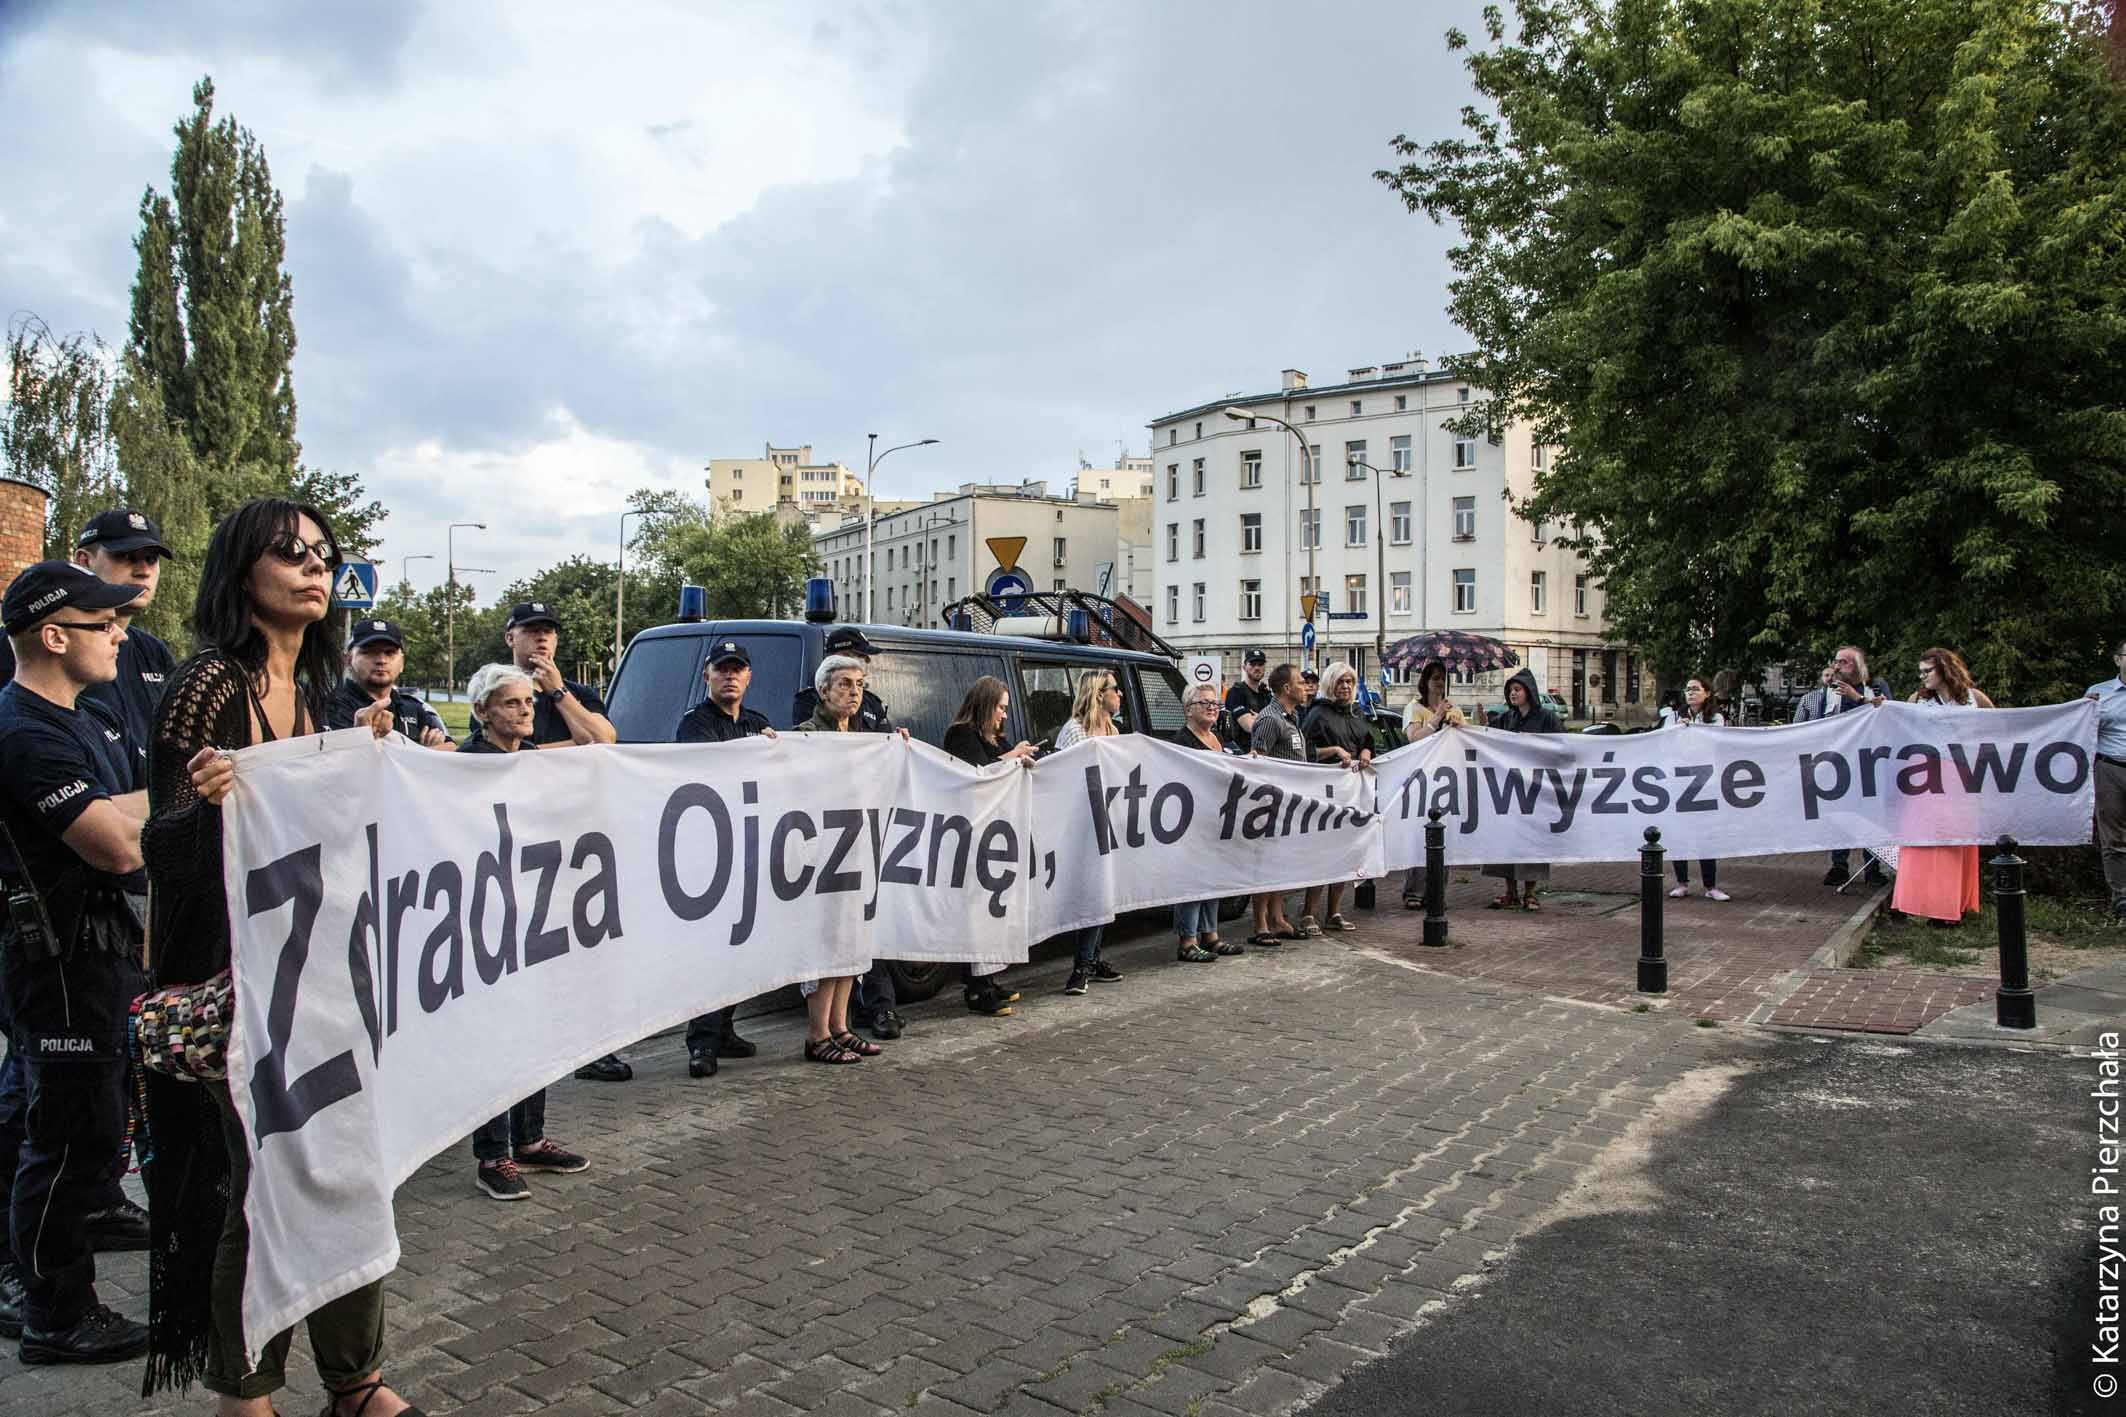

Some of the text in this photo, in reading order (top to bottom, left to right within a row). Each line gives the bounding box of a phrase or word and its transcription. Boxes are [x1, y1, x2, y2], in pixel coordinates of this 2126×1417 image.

[28, 587, 68, 614] POLICJA
[37, 779, 89, 814] POLICJA
[246, 802, 624, 1151] Zdradza
[1085, 763, 1194, 856] kto
[1400, 748, 1767, 835] najwyższe
[1800, 740, 2090, 820] prawo
[40, 1039, 94, 1052] POLICJA
